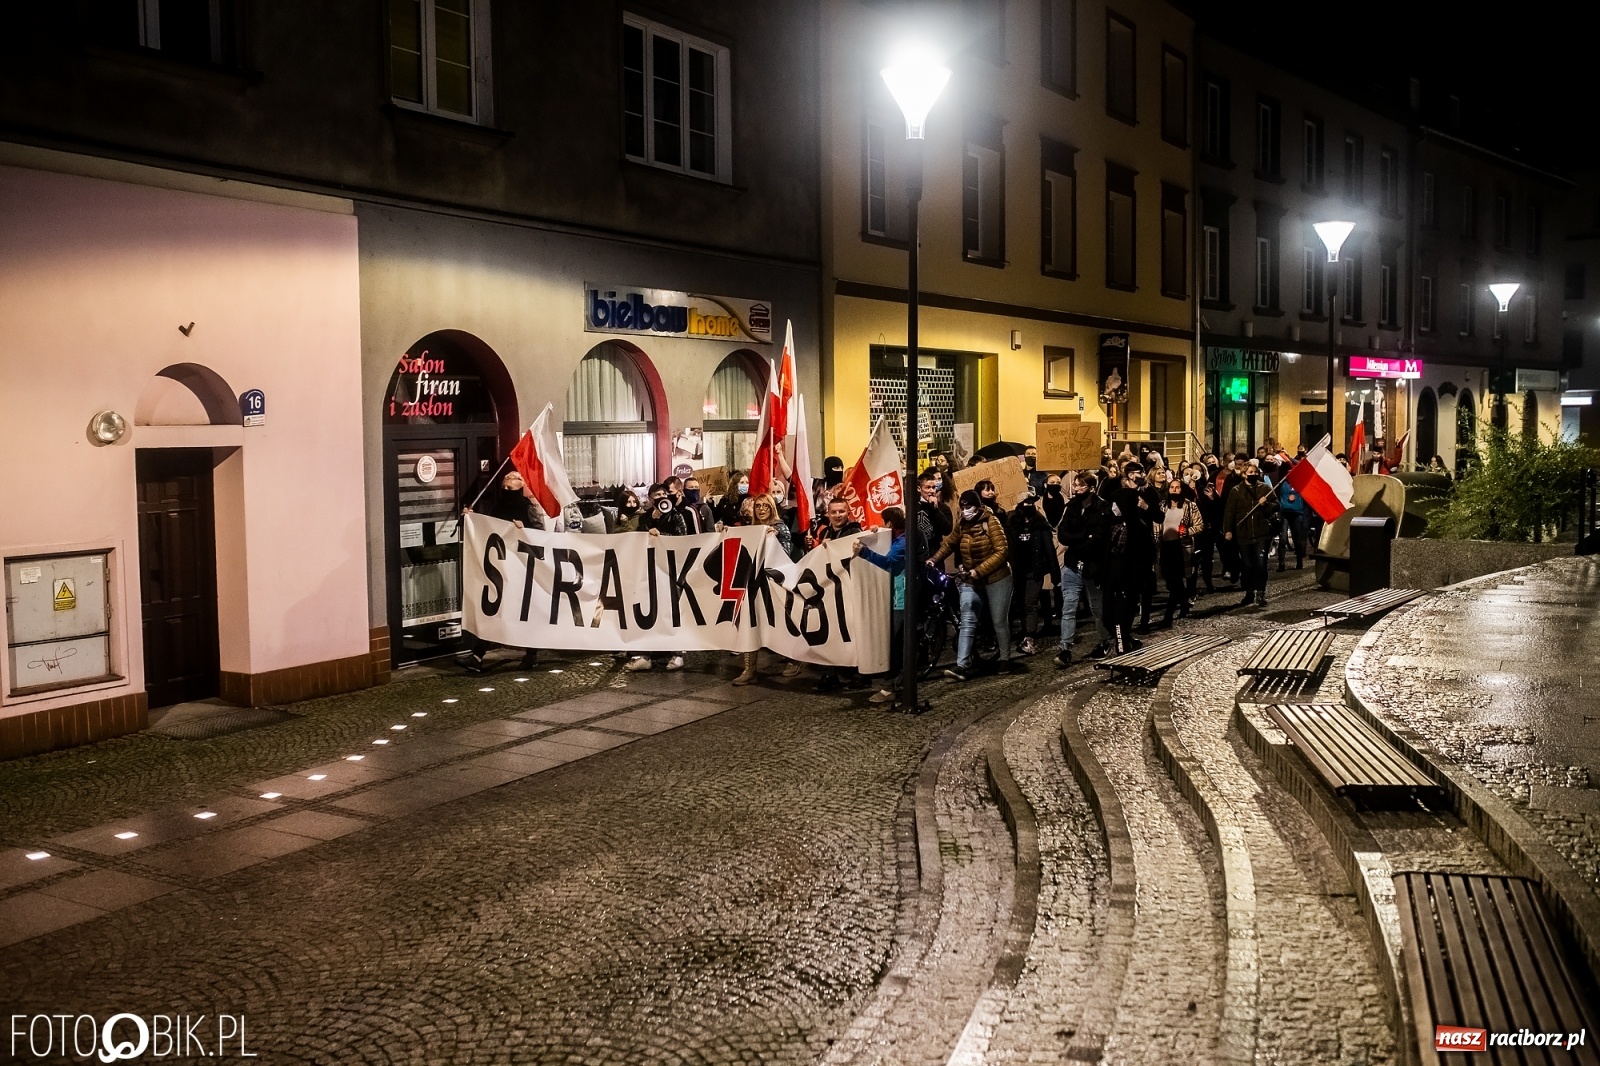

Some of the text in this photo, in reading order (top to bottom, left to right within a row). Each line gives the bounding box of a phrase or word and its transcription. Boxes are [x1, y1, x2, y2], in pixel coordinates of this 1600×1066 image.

[688, 308, 740, 337] home
[399, 350, 445, 373] Salon
[1240, 349, 1280, 371] TATTOO
[409, 370, 460, 405] firan
[249, 395, 261, 409] 16
[390, 396, 395, 416] i
[481, 533, 706, 630] STRAJK
